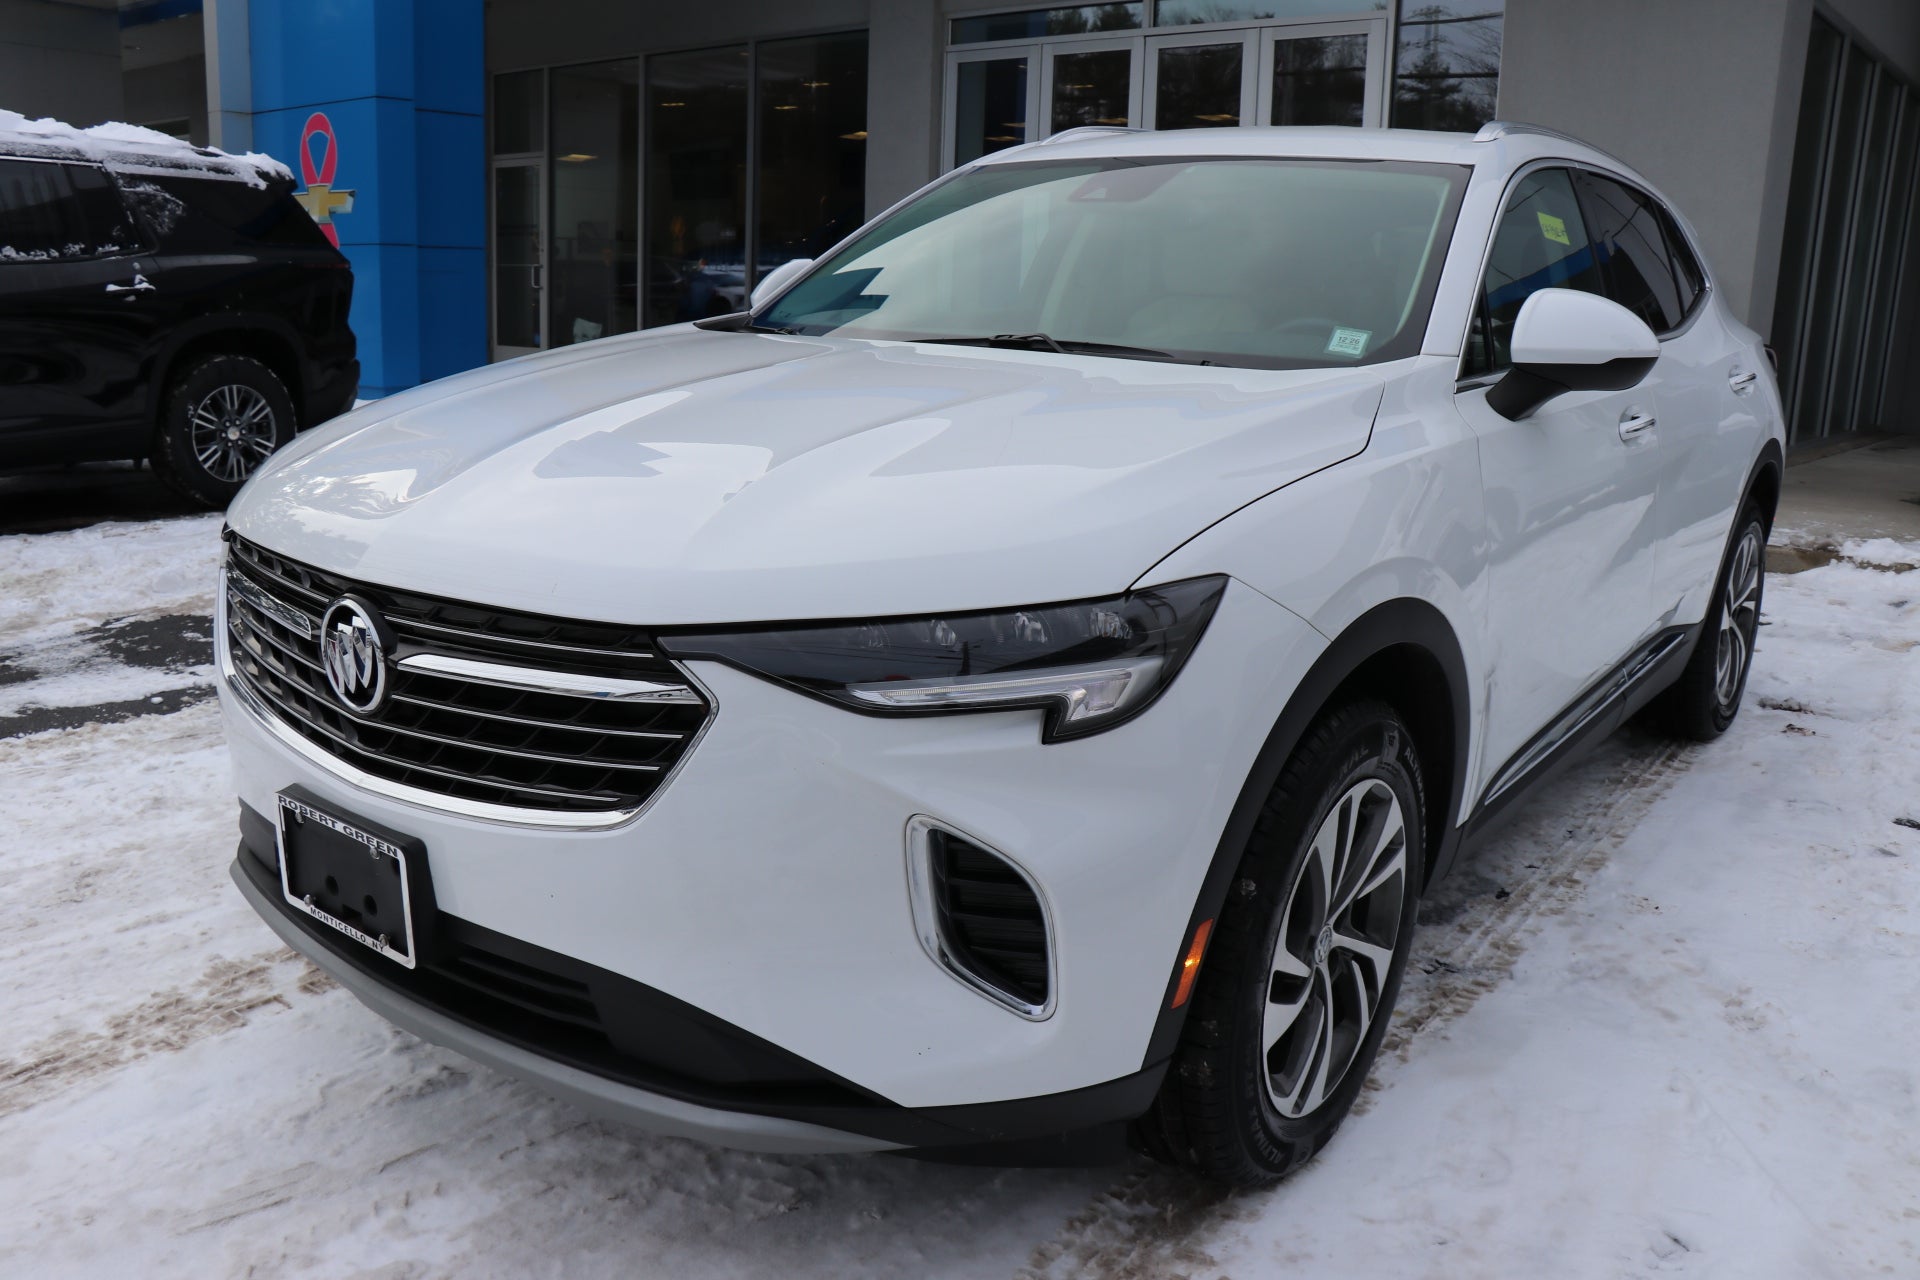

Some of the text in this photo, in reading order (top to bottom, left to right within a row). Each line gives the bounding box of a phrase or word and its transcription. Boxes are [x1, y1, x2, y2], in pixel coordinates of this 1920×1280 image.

[278, 795, 398, 858] ROBERT GREEN
[372, 940, 386, 952] NY
